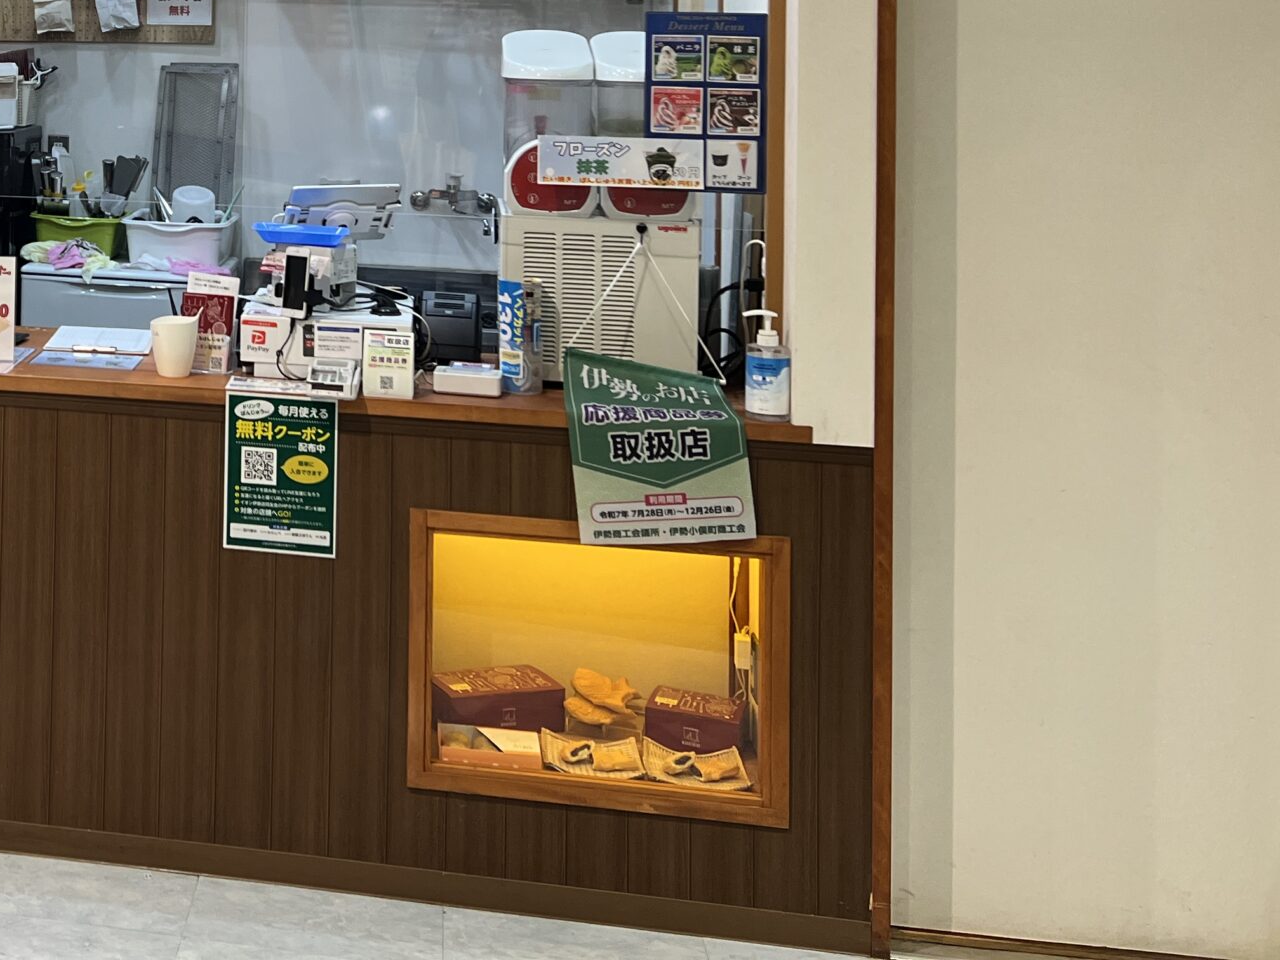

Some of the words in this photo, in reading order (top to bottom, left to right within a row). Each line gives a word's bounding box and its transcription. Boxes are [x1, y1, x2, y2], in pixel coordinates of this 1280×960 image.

[169, 5, 190, 16] 無料
[668, 21, 708, 30] Dessert
[712, 22, 745, 31] Menu
[554, 142, 631, 157] フローズン
[576, 158, 609, 175] 抹茶
[247, 345, 269, 353] PayPay
[580, 364, 710, 405] 伊勢のお店
[278, 405, 329, 419] 毎月使える
[235, 420, 330, 442] 無料クーポン
[298, 442, 326, 454] 配布中
[609, 428, 710, 464] 取扱店
[599, 509, 629, 519] 令和7年
